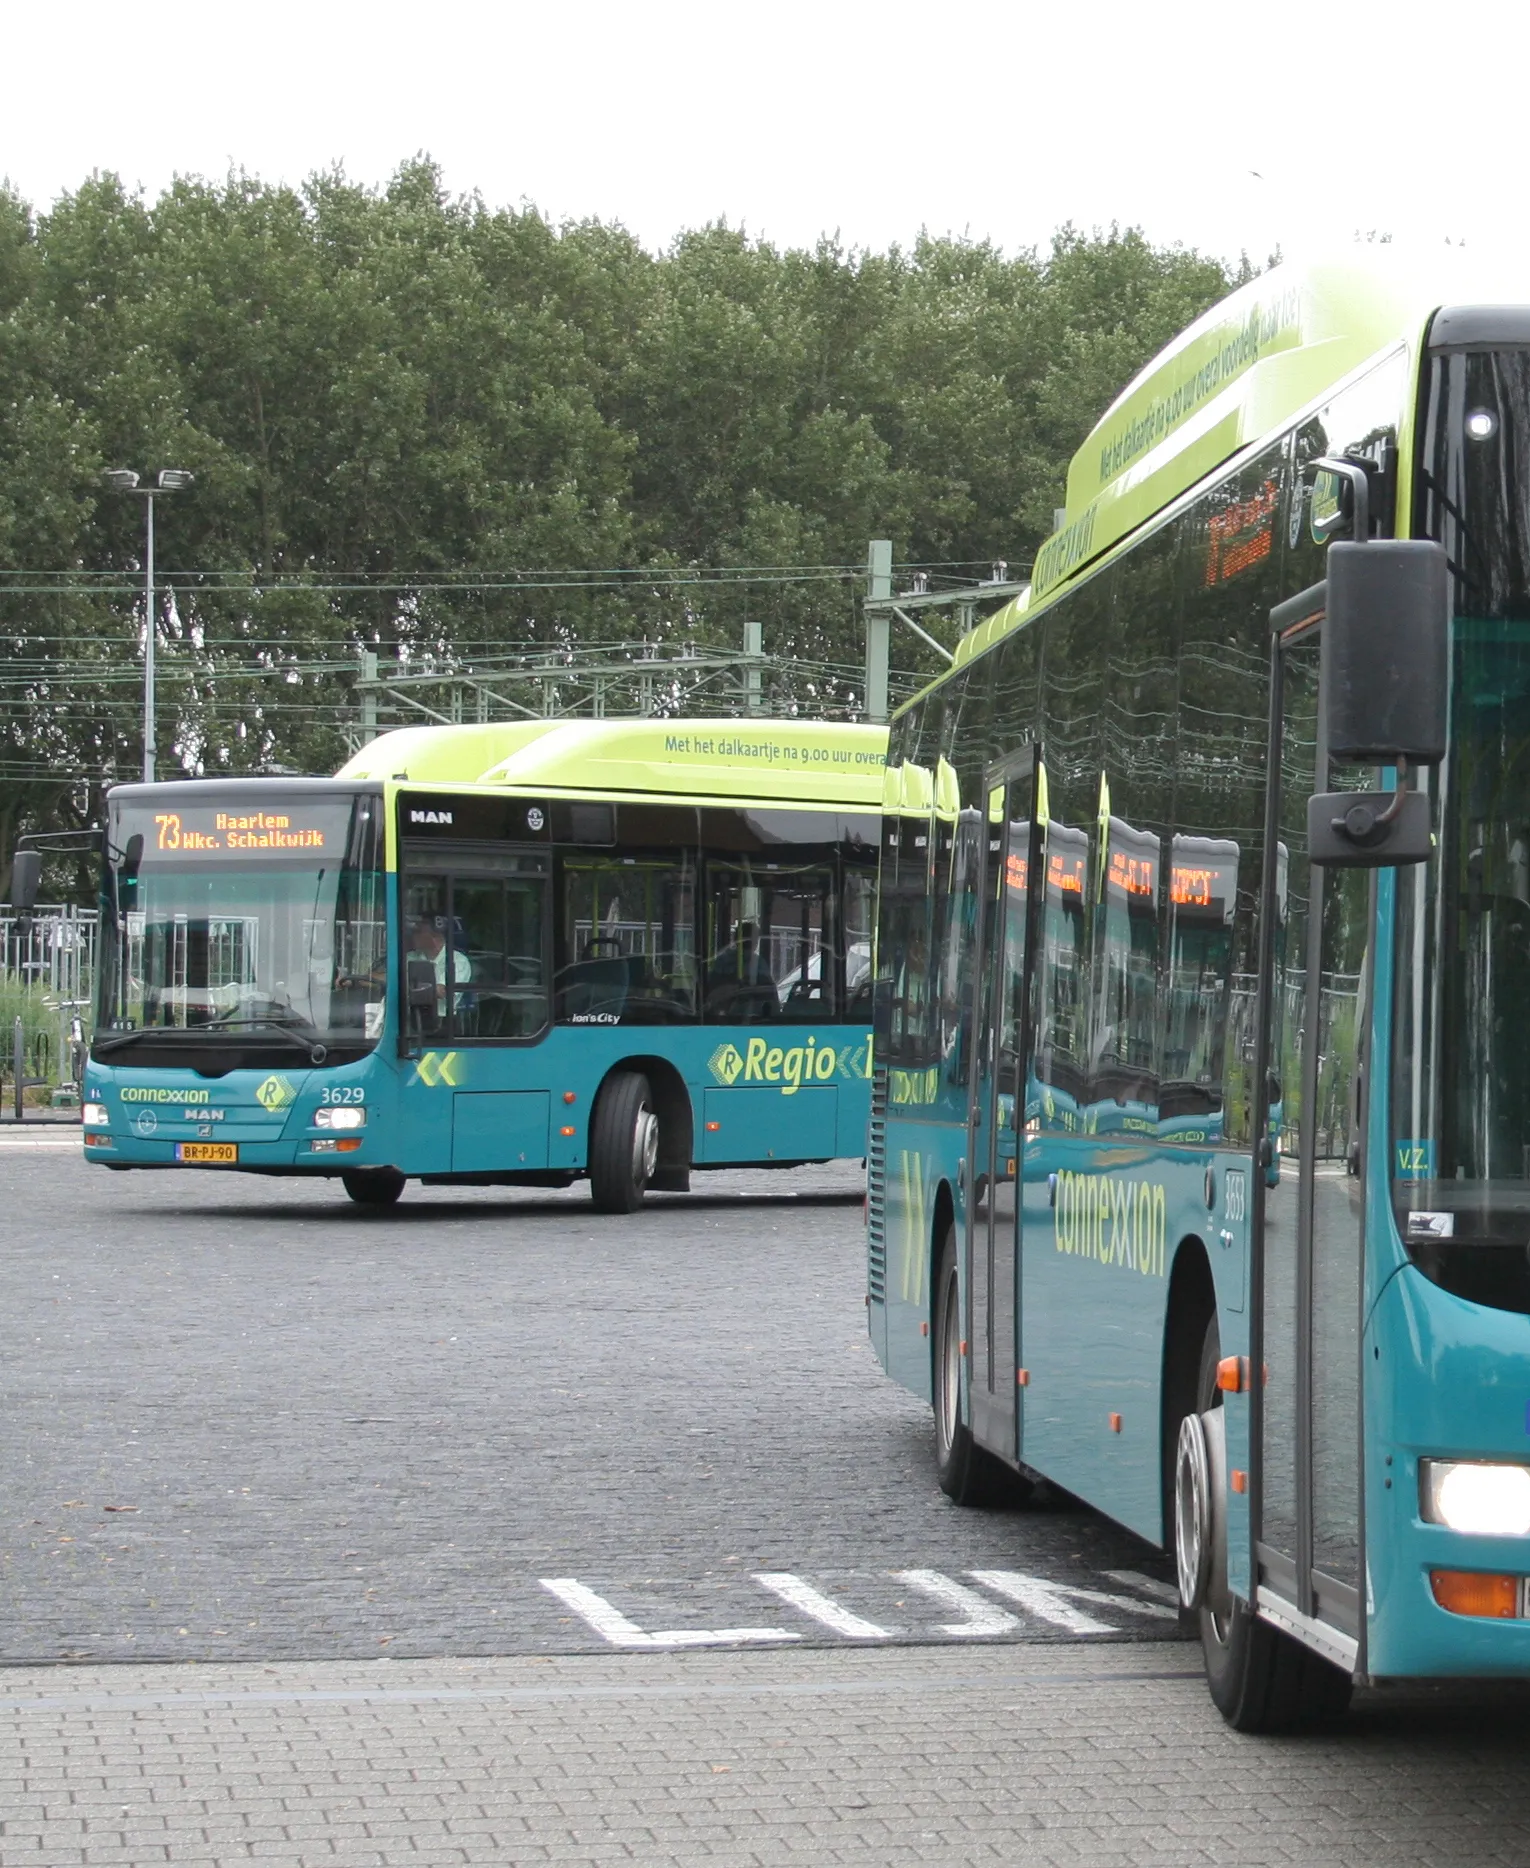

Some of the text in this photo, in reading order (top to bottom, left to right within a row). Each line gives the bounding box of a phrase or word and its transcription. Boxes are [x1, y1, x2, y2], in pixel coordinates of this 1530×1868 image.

[665, 735, 690, 753] Met
[694, 737, 714, 755] het
[718, 738, 780, 763] dalkaartje
[783, 746, 798, 760] na
[801, 748, 829, 764] 9.00
[832, 750, 852, 763] uur
[410, 810, 453, 825] MAN
[155, 813, 289, 850] 73 Haarlem
[227, 830, 325, 848] Schalkwijk
[744, 1034, 837, 1095] Regio
[120, 1087, 210, 1104] connexxion
[321, 1087, 365, 1104] 3629
[184, 1109, 225, 1121] MAN
[183, 1146, 233, 1159] BR-PJ-90
[1055, 1168, 1165, 1277] connexxion
